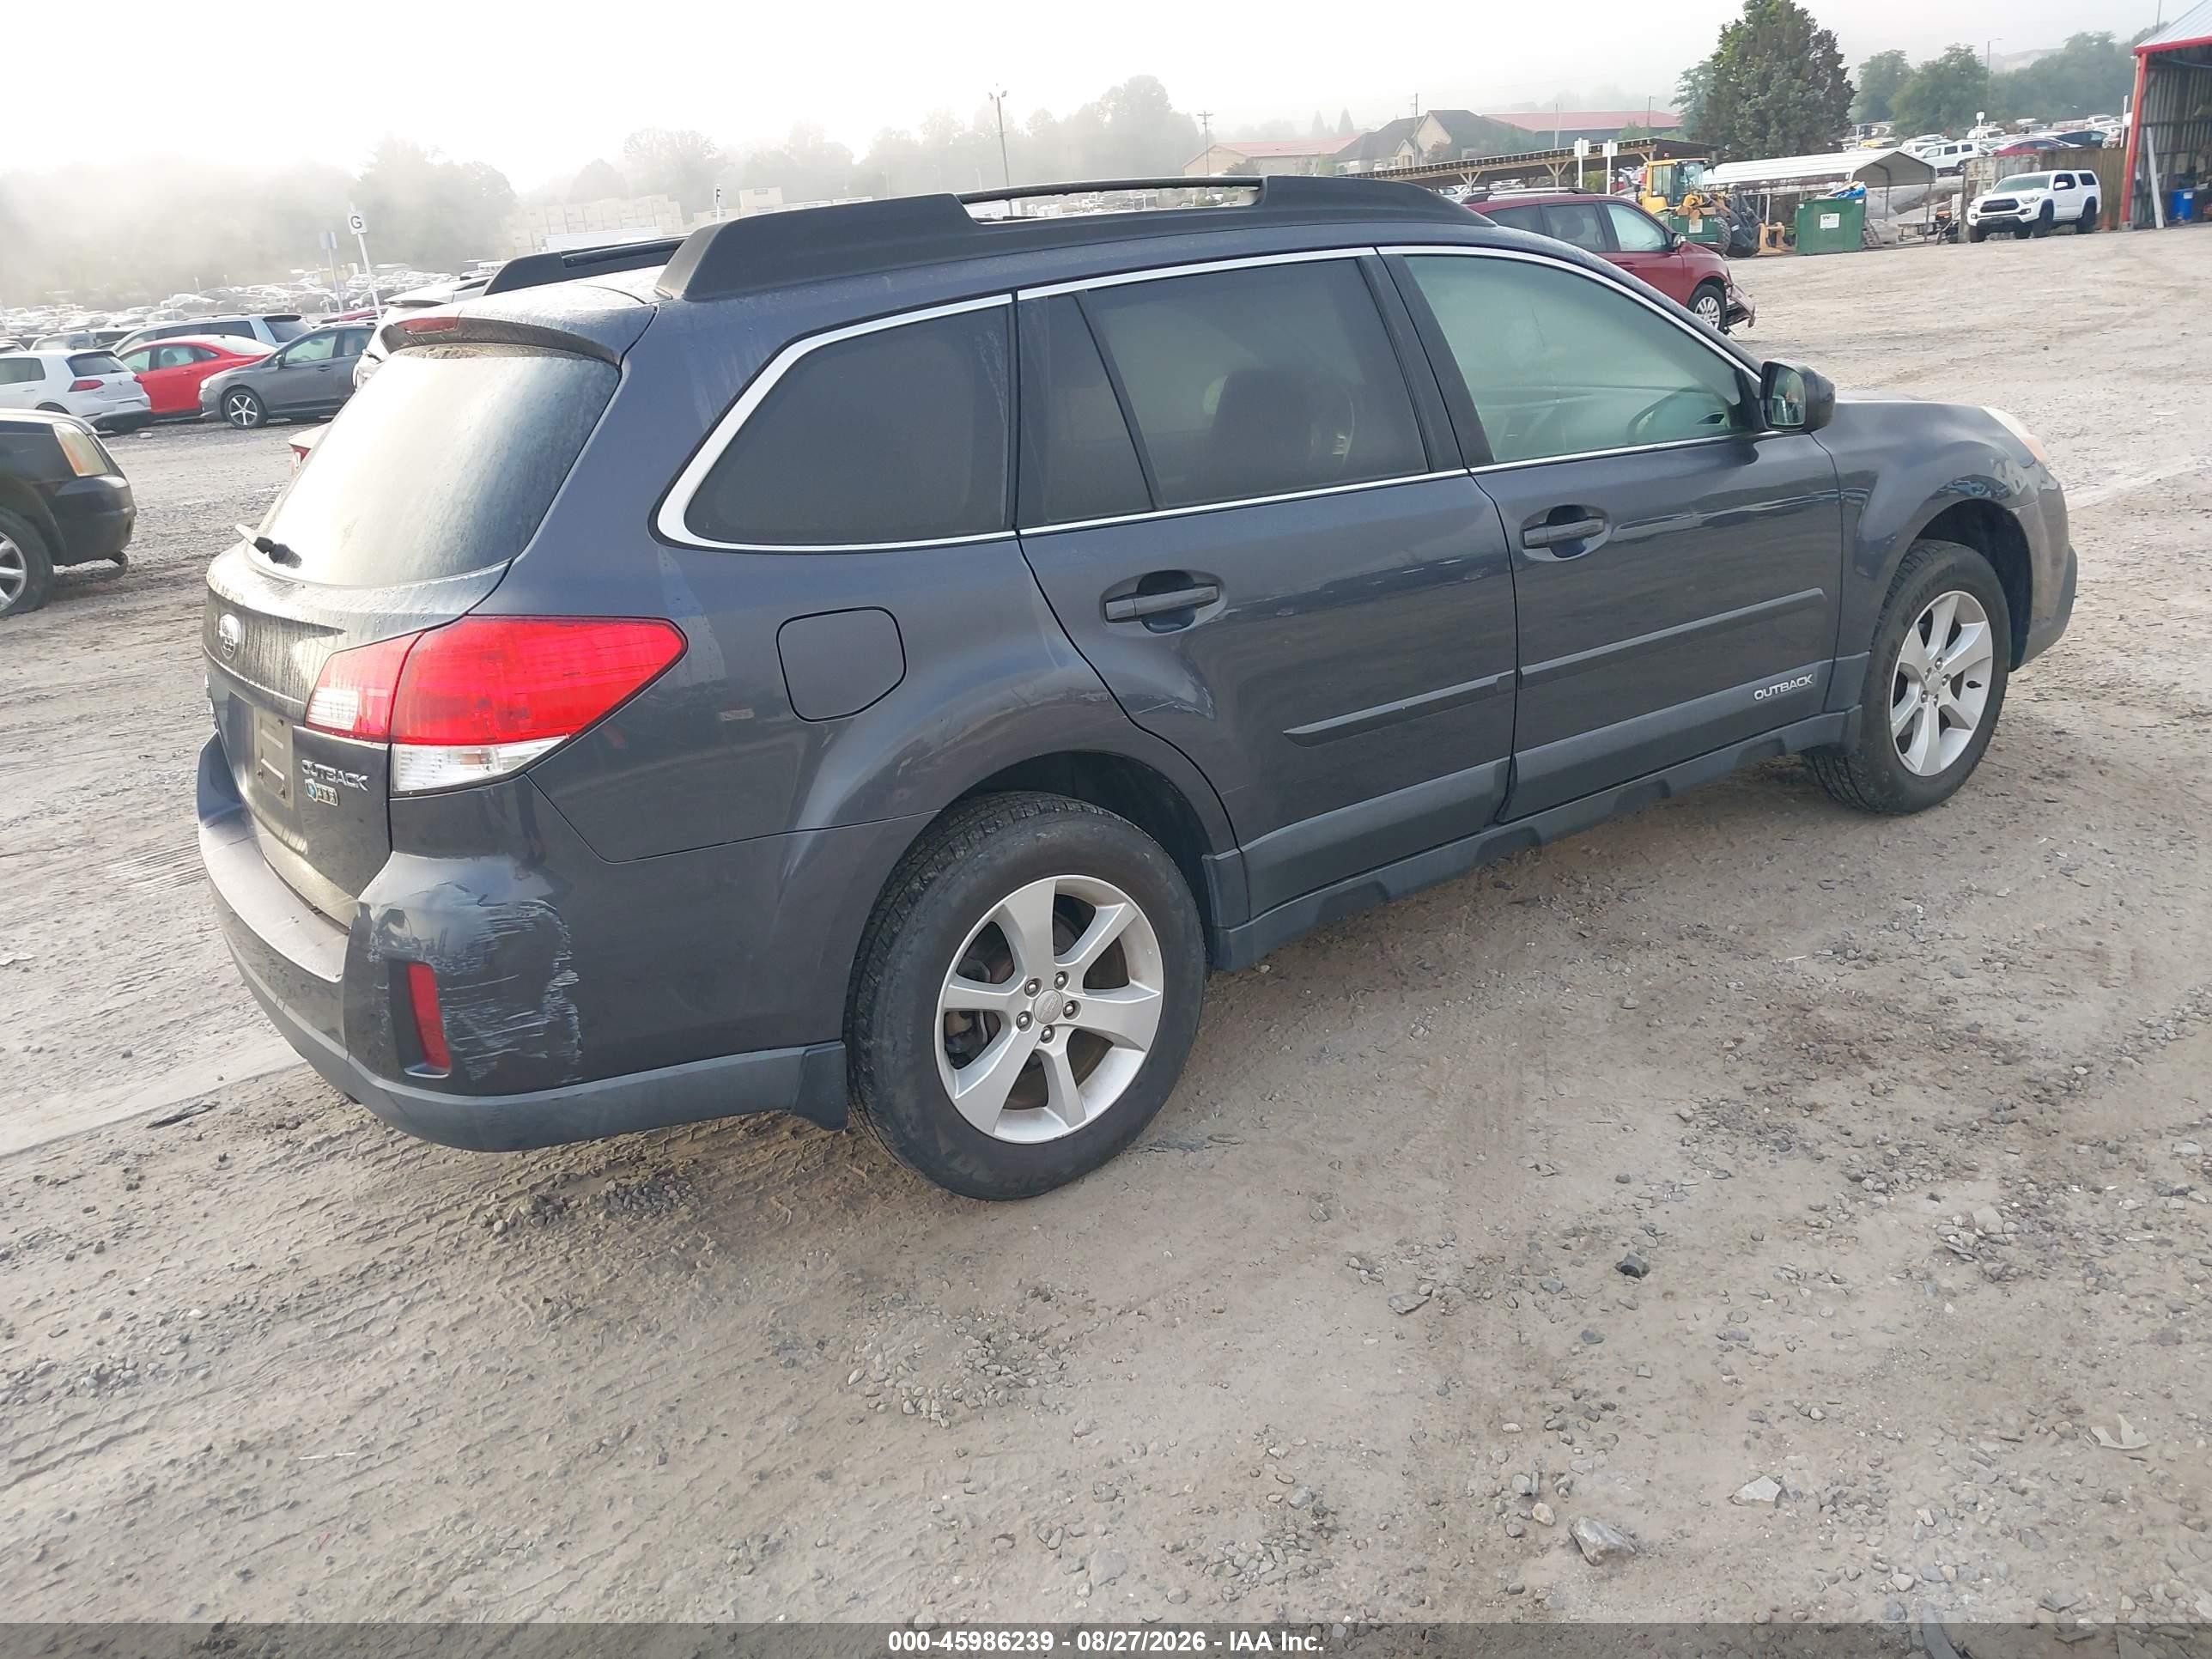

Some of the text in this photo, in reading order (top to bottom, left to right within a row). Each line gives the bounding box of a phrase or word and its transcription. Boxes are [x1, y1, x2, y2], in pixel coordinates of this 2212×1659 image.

[350, 216, 362, 229] G
[1753, 673, 1814, 701] OUTBACK
[301, 759, 369, 792] OUTBACK
